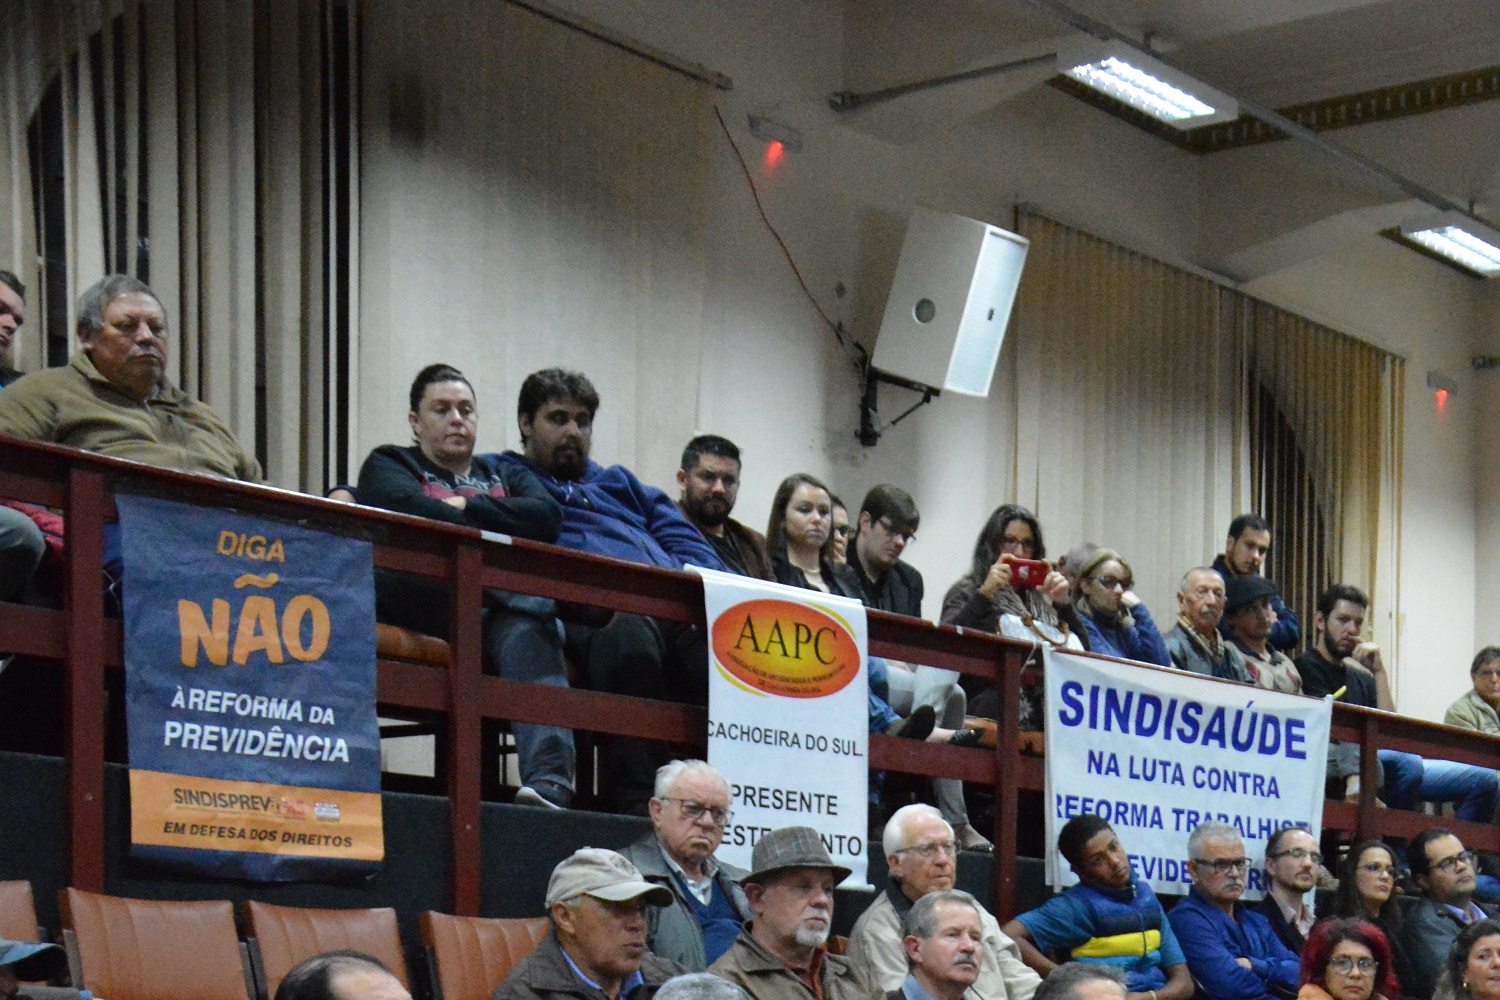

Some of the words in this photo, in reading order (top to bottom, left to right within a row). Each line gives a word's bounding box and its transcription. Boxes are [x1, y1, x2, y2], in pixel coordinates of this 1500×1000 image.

[217, 530, 285, 563] DIGA
[177, 573, 331, 667] NÃO
[734, 613, 837, 665] AAPC
[171, 685, 185, 709] À
[188, 687, 303, 722] REFORMA
[308, 706, 335, 725] DA
[1058, 680, 1307, 760] SINDISAÚDE
[164, 720, 350, 763] PREVIDÊNCIA
[708, 720, 801, 749] CACHOEIRA
[805, 734, 828, 752] DO
[1087, 749, 1120, 778] NA
[1129, 755, 1185, 786] LUTA
[1192, 765, 1280, 799] CONTRA
[163, 821, 185, 835] EM
[189, 823, 246, 840] DEFESA
[250, 828, 277, 842] DOS
[281, 831, 353, 848] DIREITOS
